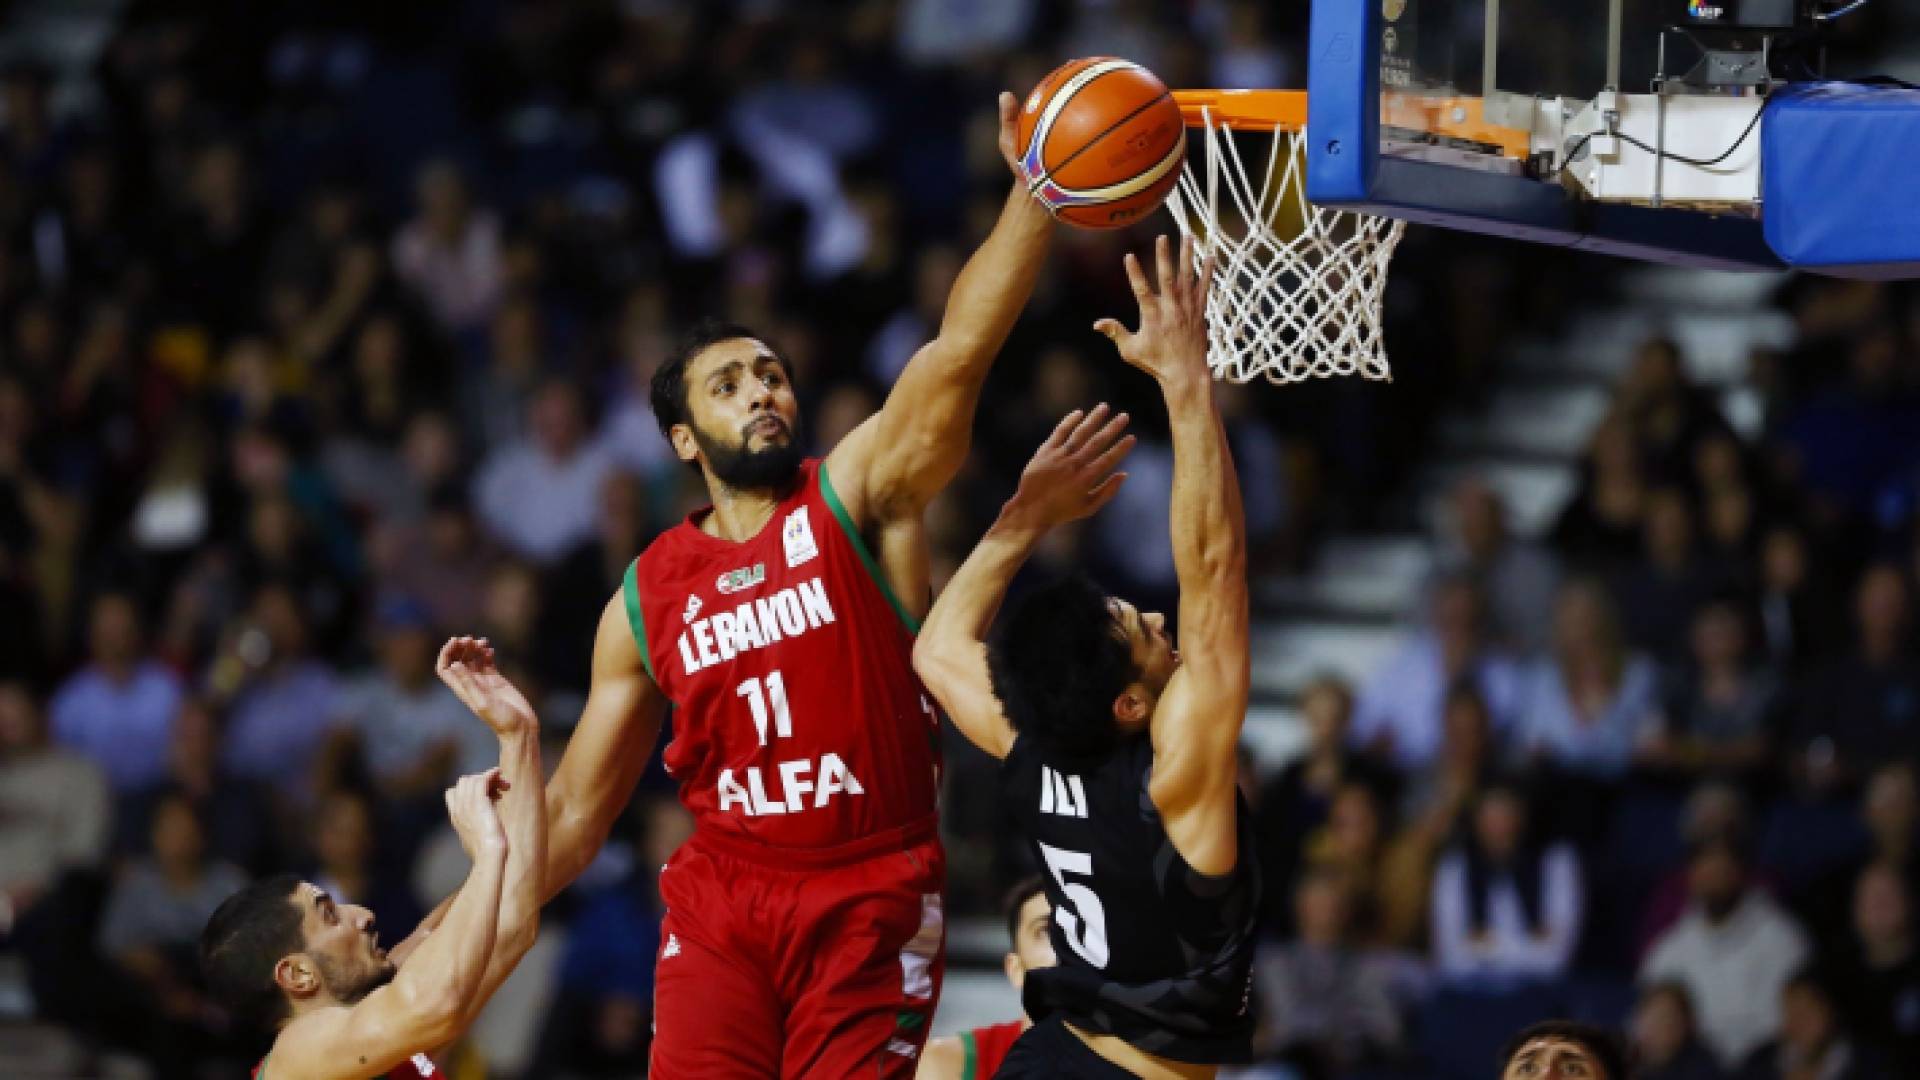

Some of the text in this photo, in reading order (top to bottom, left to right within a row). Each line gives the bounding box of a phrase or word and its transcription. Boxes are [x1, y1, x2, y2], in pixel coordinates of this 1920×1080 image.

[677, 577, 836, 675] LEBANON
[736, 670, 793, 746] 11
[717, 752, 865, 817] ALFA
[1037, 840, 1110, 970] 5
